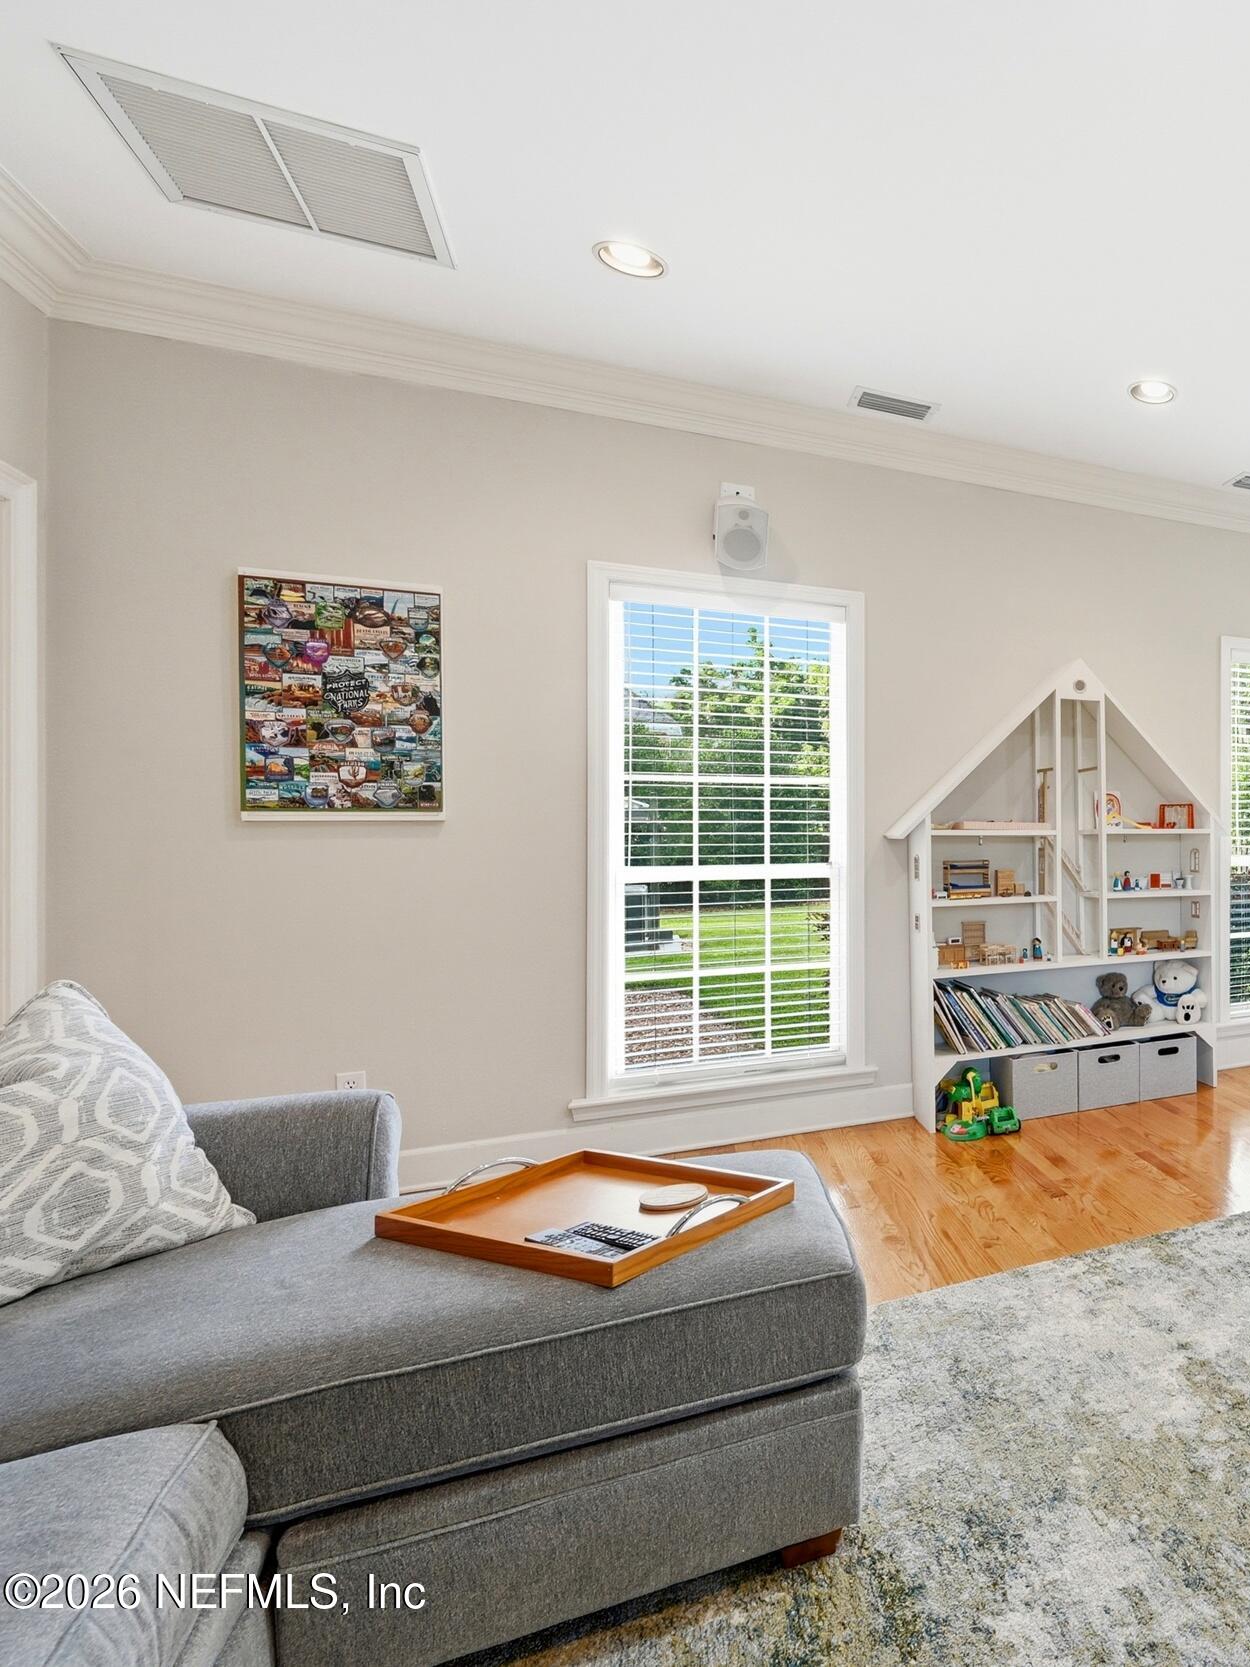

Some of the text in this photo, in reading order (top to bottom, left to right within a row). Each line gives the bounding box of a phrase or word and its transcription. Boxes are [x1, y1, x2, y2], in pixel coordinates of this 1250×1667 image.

[327, 679, 367, 690] PROTECT
[324, 689, 370, 701] NATIONAL
[337, 698, 364, 713] PARKS
